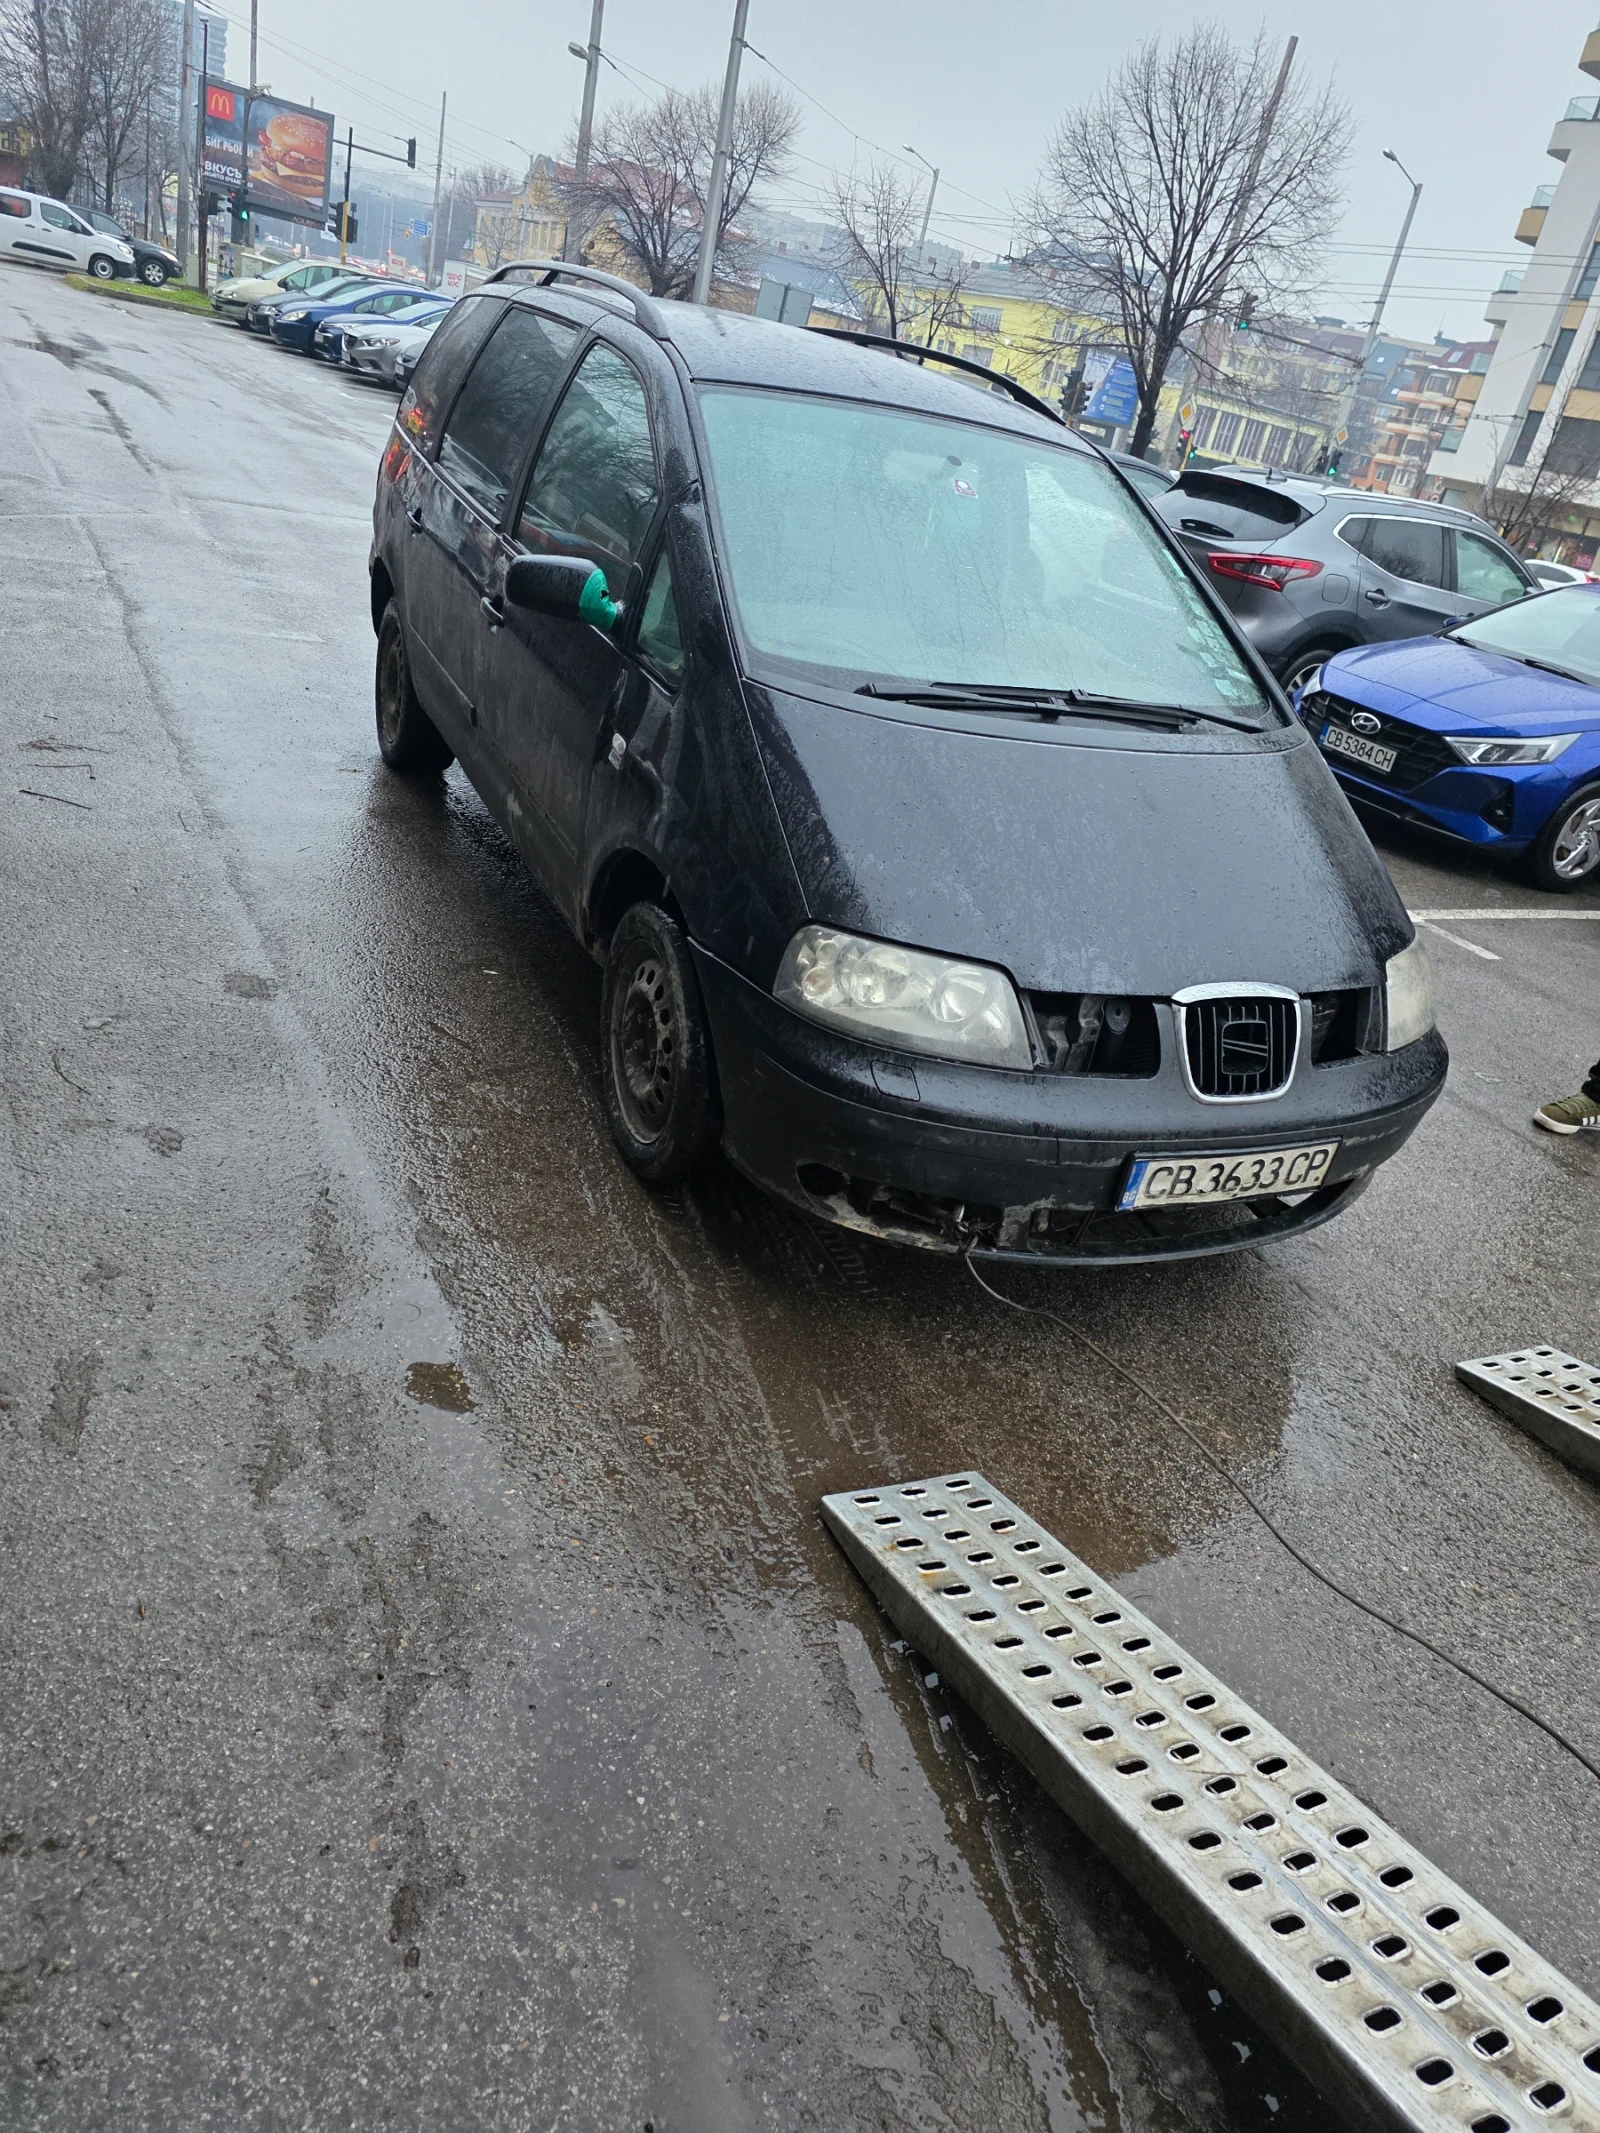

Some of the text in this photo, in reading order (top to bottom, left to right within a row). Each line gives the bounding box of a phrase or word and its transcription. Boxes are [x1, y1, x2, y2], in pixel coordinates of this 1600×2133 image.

[205, 136, 222, 150] БИГ
[205, 161, 242, 178] ВКУСЪ
[1326, 729, 1394, 769] CB 5384 CH
[1144, 1148, 1330, 1199] CB 3633 CP
[1121, 1191, 1138, 1203] BG
